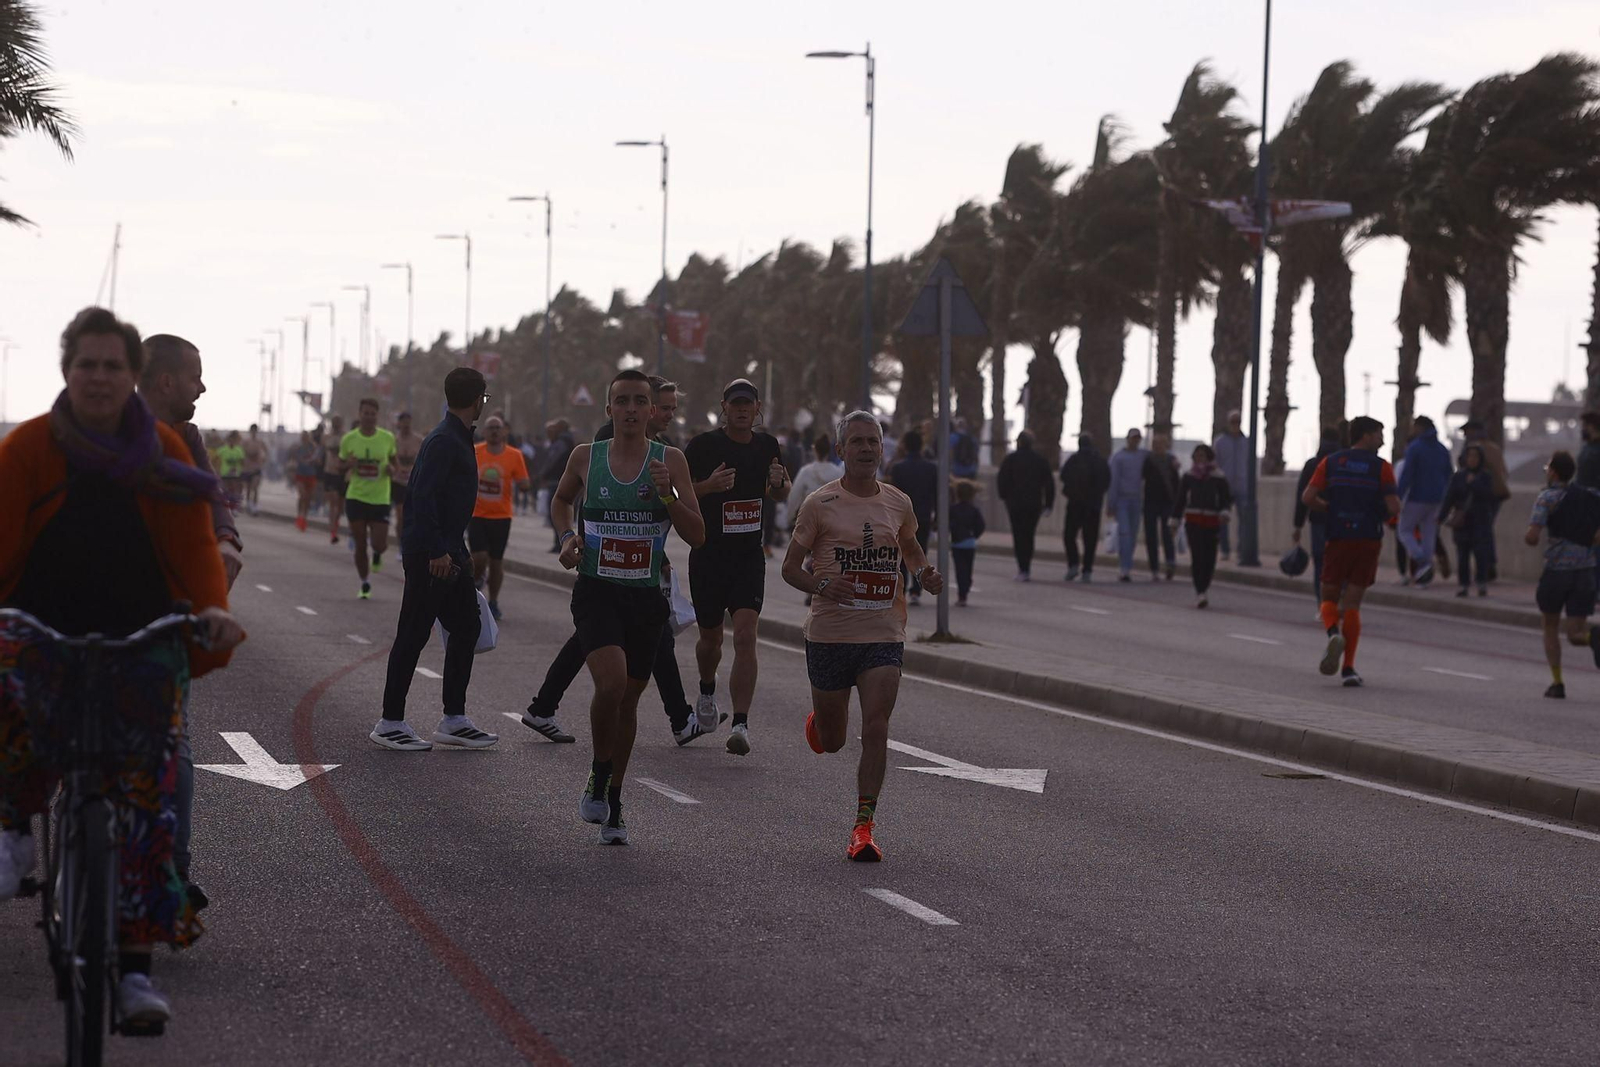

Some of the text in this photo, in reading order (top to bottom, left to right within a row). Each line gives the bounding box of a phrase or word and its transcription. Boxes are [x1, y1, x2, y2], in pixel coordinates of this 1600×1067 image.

[604, 511, 652, 522] ATLETISMO
[744, 510, 760, 519] 1343
[596, 524, 660, 536] TORREMOLINOS
[632, 553, 642, 562] 91
[834, 546, 898, 564] BRUNCH
[873, 586, 890, 594] 140
